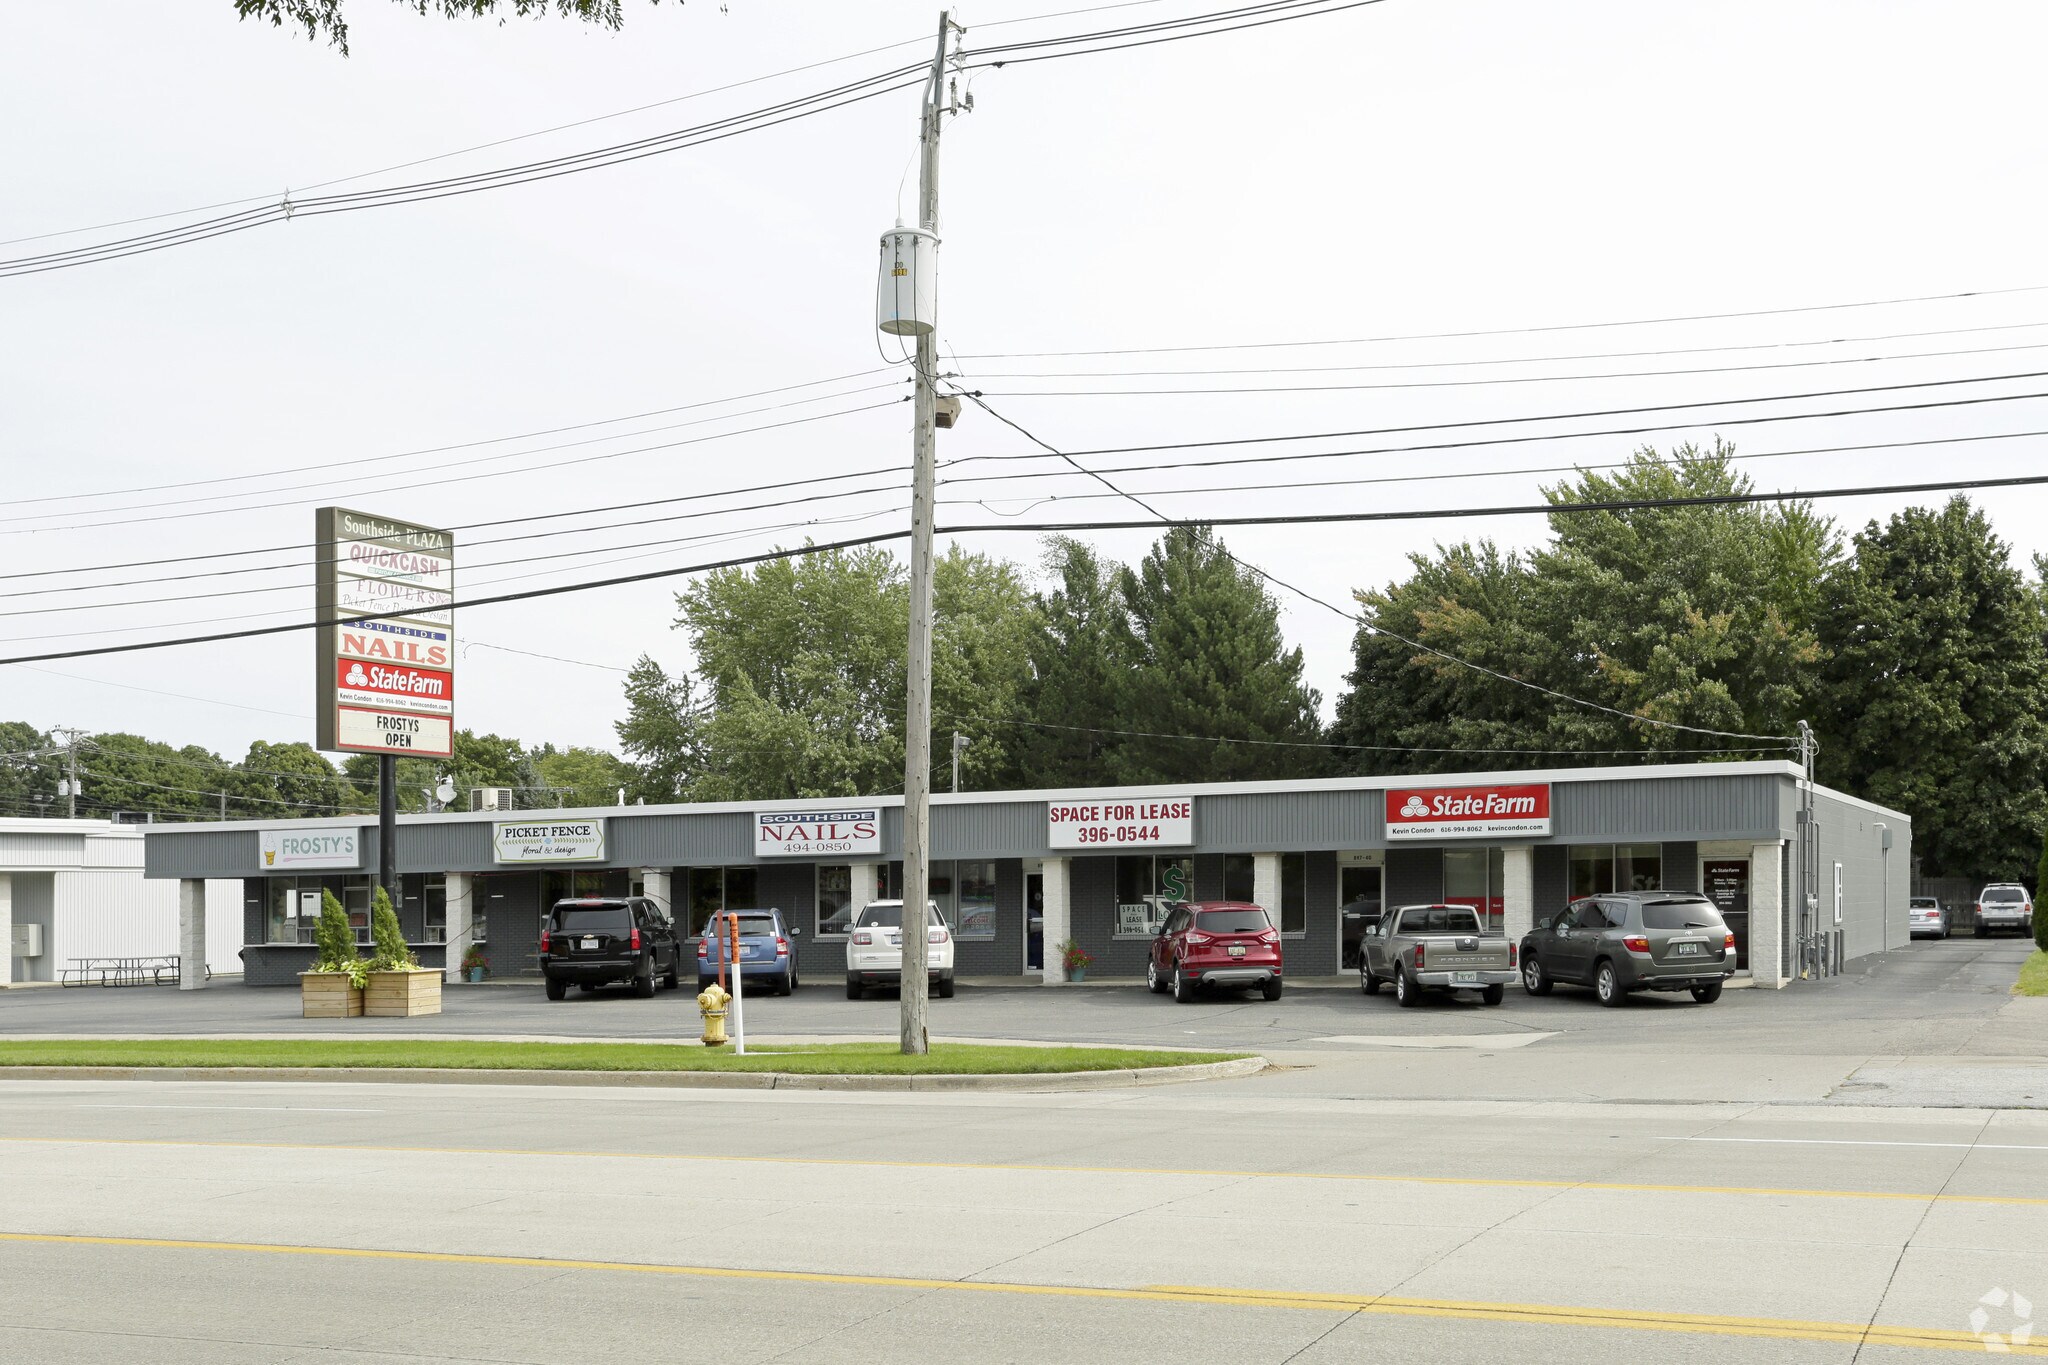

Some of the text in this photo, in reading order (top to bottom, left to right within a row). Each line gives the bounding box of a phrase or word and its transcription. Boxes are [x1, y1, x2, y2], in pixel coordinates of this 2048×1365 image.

[344, 515, 444, 551] Southside PLAZA
[350, 544, 440, 577] QUICKCASH
[342, 594, 366, 608] Picket
[357, 579, 435, 605] FLOWERS
[354, 620, 436, 639] SOUTHSIDE
[342, 633, 447, 666] NAILS
[369, 666, 442, 695] StateFarm
[354, 694, 372, 702] Condon
[410, 702, 448, 710] kevincondon.com
[376, 716, 419, 732] FROSTYS
[386, 732, 412, 747] OPEN
[1050, 803, 1190, 822] SPACE FOR LEASE
[1432, 793, 1535, 816] StateFarm
[762, 812, 874, 823] SOUTHSIDE
[505, 826, 590, 838] PICKET FENCE
[760, 822, 876, 841] NAILS
[1078, 826, 1160, 842] 396-0544
[282, 836, 354, 854] FROSTY'S
[521, 846, 542, 858] floral
[554, 846, 576, 856] design
[784, 842, 852, 852] 494-0850
